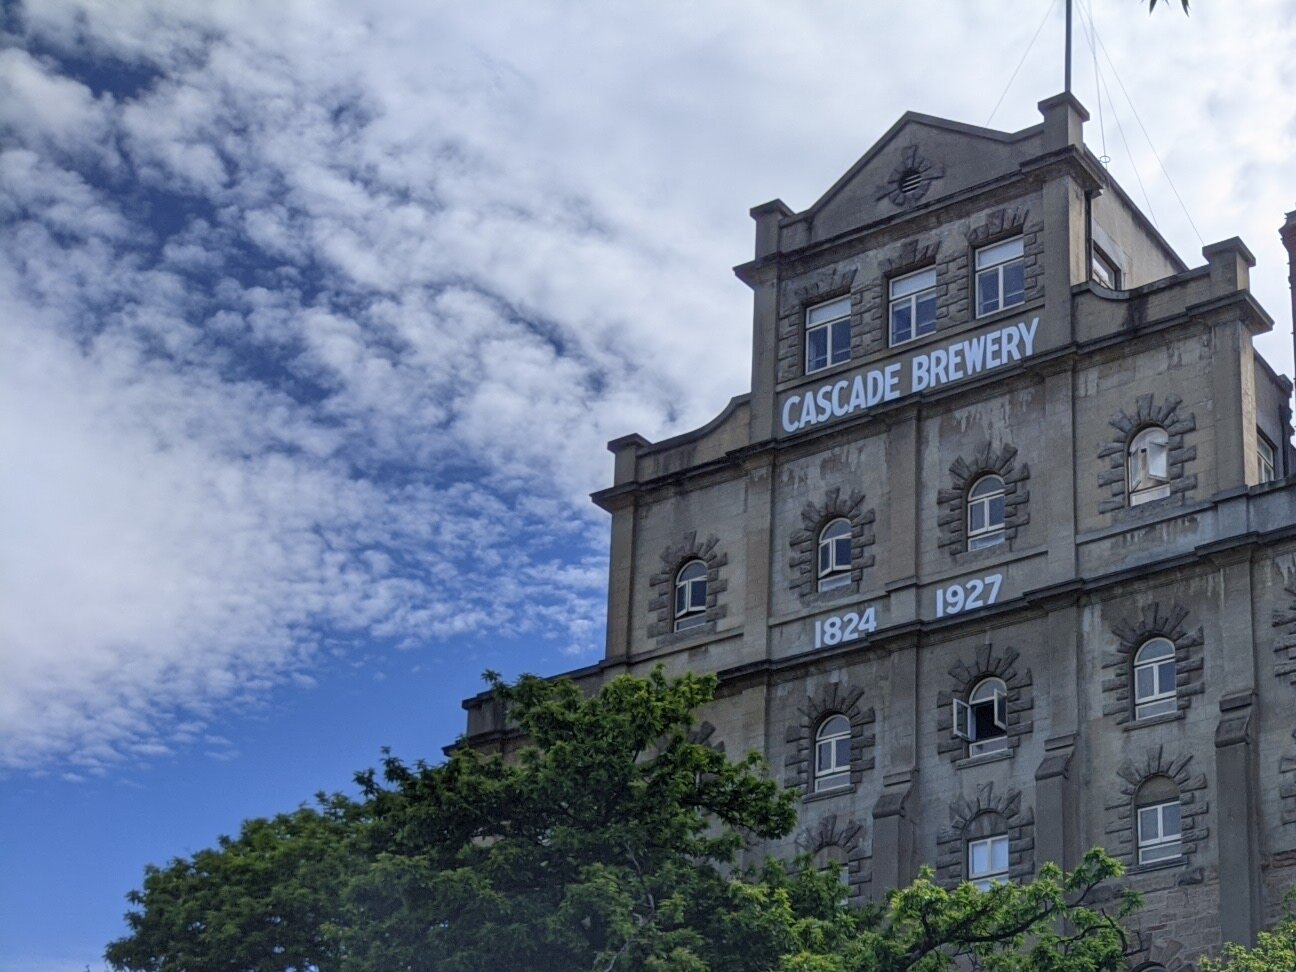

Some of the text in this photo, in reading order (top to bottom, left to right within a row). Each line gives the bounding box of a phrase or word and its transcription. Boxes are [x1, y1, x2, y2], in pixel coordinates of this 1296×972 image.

[782, 317, 1039, 433] CASCADE BREWERY
[815, 573, 1003, 648] 1824 1927
